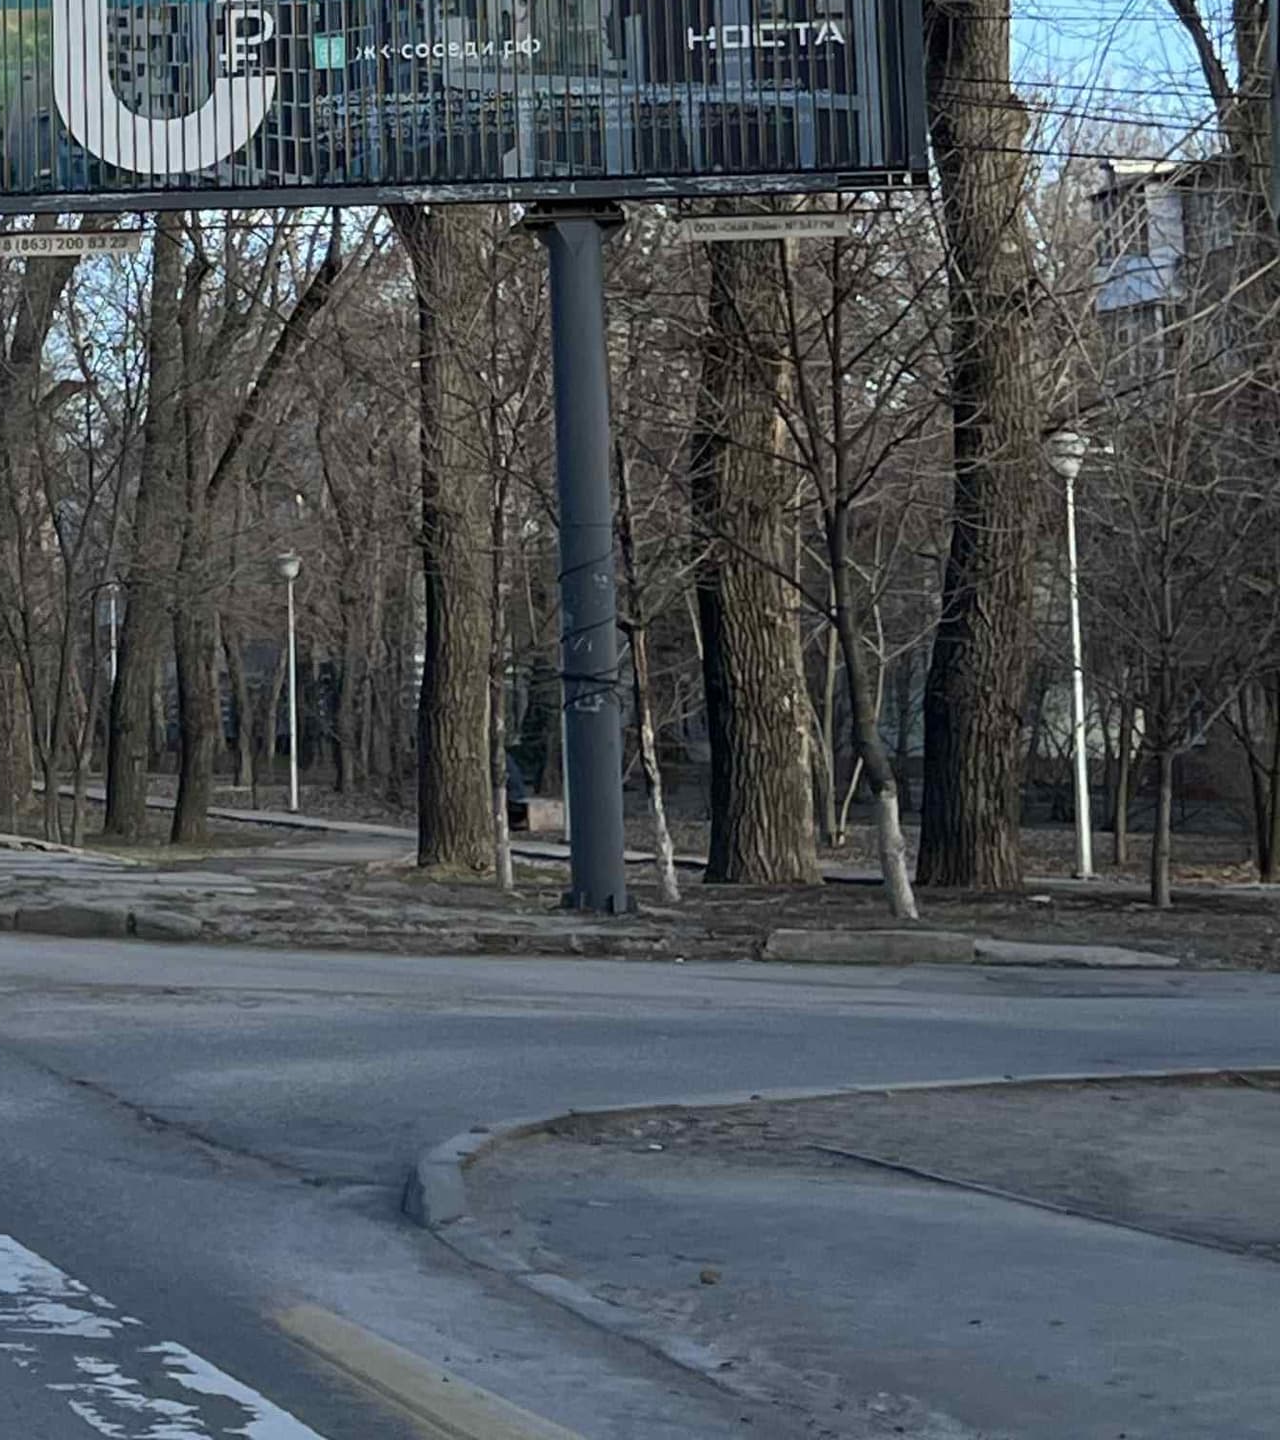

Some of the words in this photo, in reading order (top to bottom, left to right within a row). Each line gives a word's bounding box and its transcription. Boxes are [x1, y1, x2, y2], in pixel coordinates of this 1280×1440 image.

[687, 20, 845, 50] НОСТА
[3, 238, 11, 251] 8
[15, 237, 52, 253] (863)
[56, 237, 84, 250] 200
